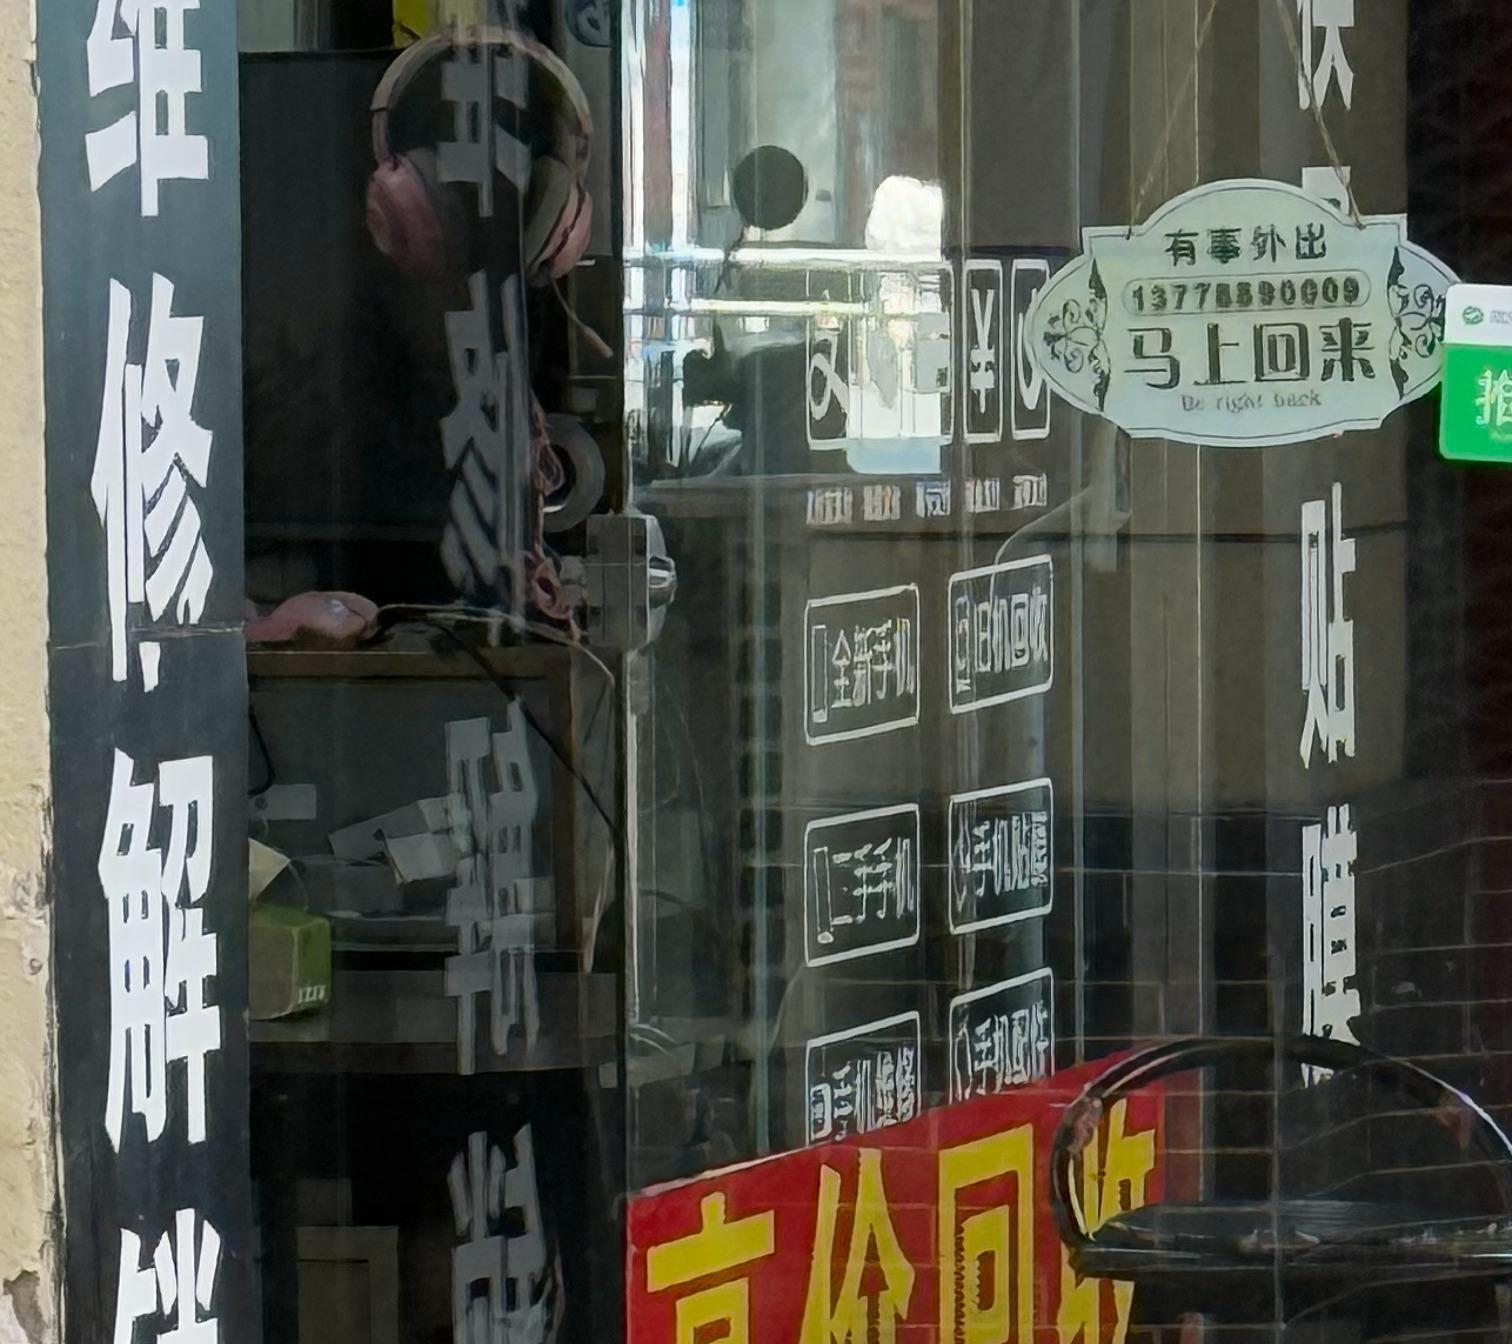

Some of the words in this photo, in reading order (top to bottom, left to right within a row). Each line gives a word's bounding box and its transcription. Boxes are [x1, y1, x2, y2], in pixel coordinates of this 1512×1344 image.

[1164, 222, 1328, 267] 有事外出
[1121, 316, 1377, 390] 马上回来
